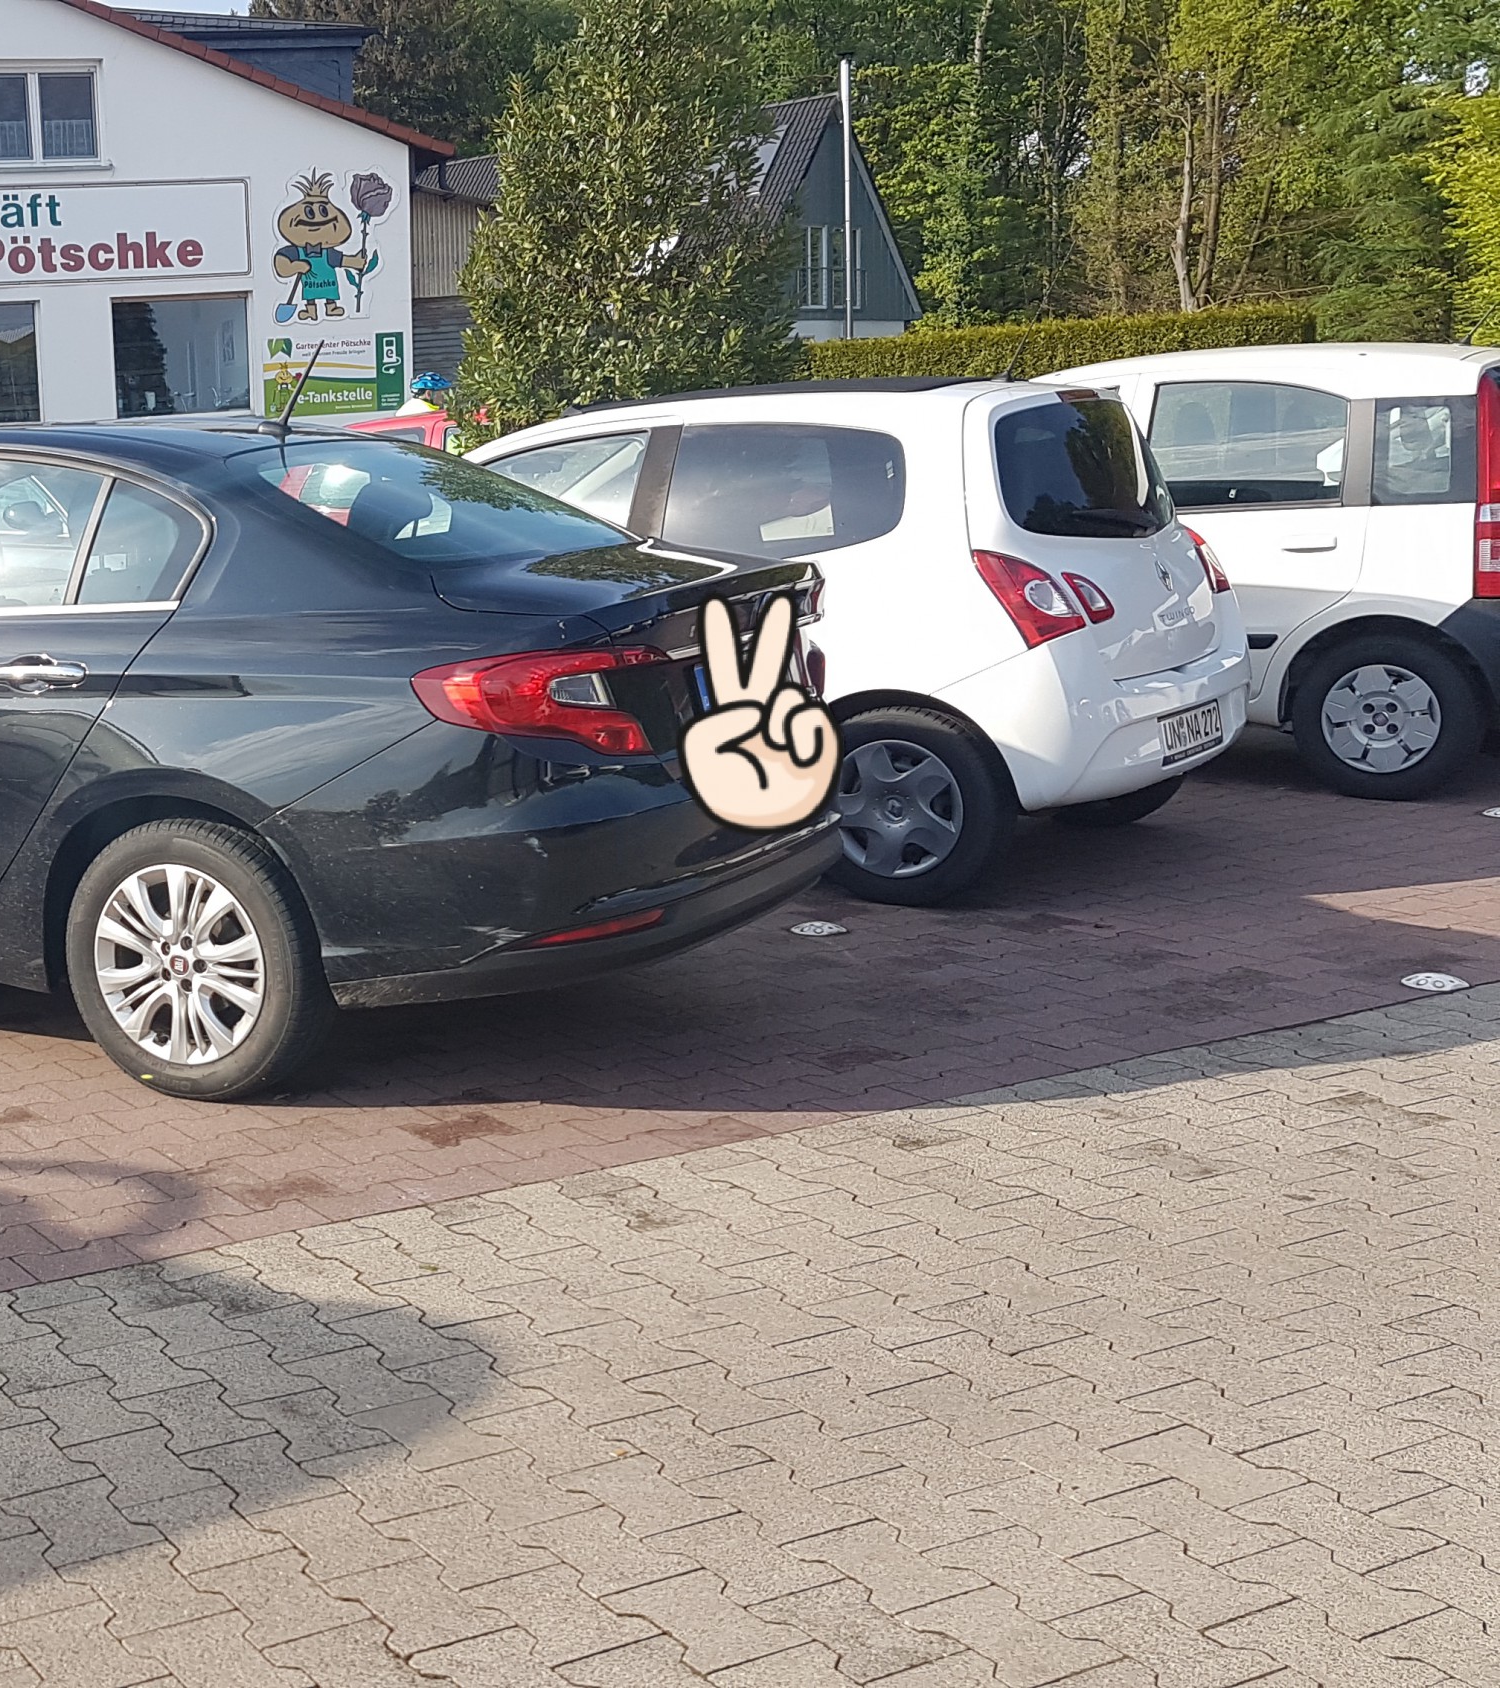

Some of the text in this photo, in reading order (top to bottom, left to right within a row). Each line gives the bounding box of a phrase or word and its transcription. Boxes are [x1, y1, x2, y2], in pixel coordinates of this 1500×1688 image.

[304, 279, 336, 288] Pötschke
[295, 339, 372, 350] Gartenenter Pötschke
[297, 387, 373, 404] e-Tankstelle
[1163, 720, 1182, 750] UN
[1185, 712, 1202, 744] NA
[1201, 705, 1220, 738] 272
